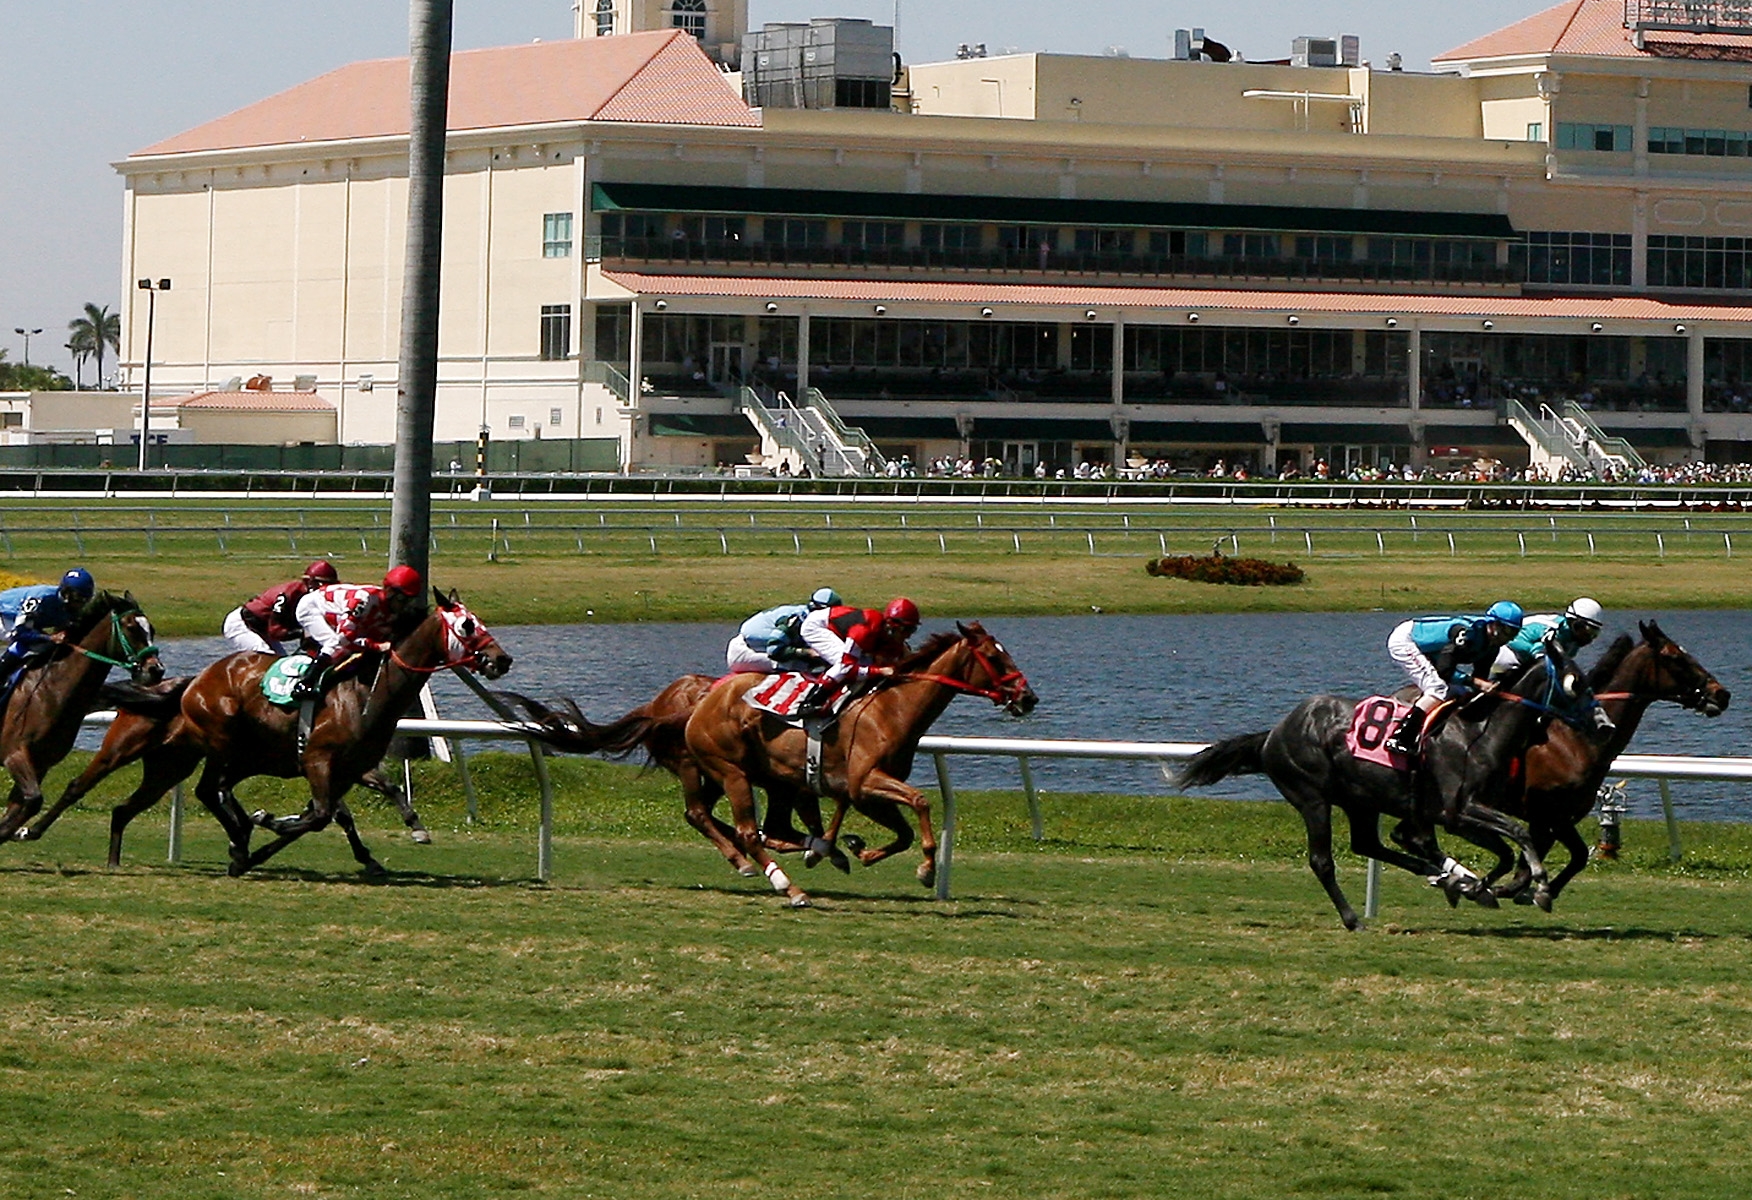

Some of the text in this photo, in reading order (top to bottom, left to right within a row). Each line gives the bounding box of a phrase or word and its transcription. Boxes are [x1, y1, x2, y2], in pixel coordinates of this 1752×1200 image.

[272, 595, 286, 613] 2
[754, 673, 810, 715] 11
[1356, 700, 1394, 751] 8
